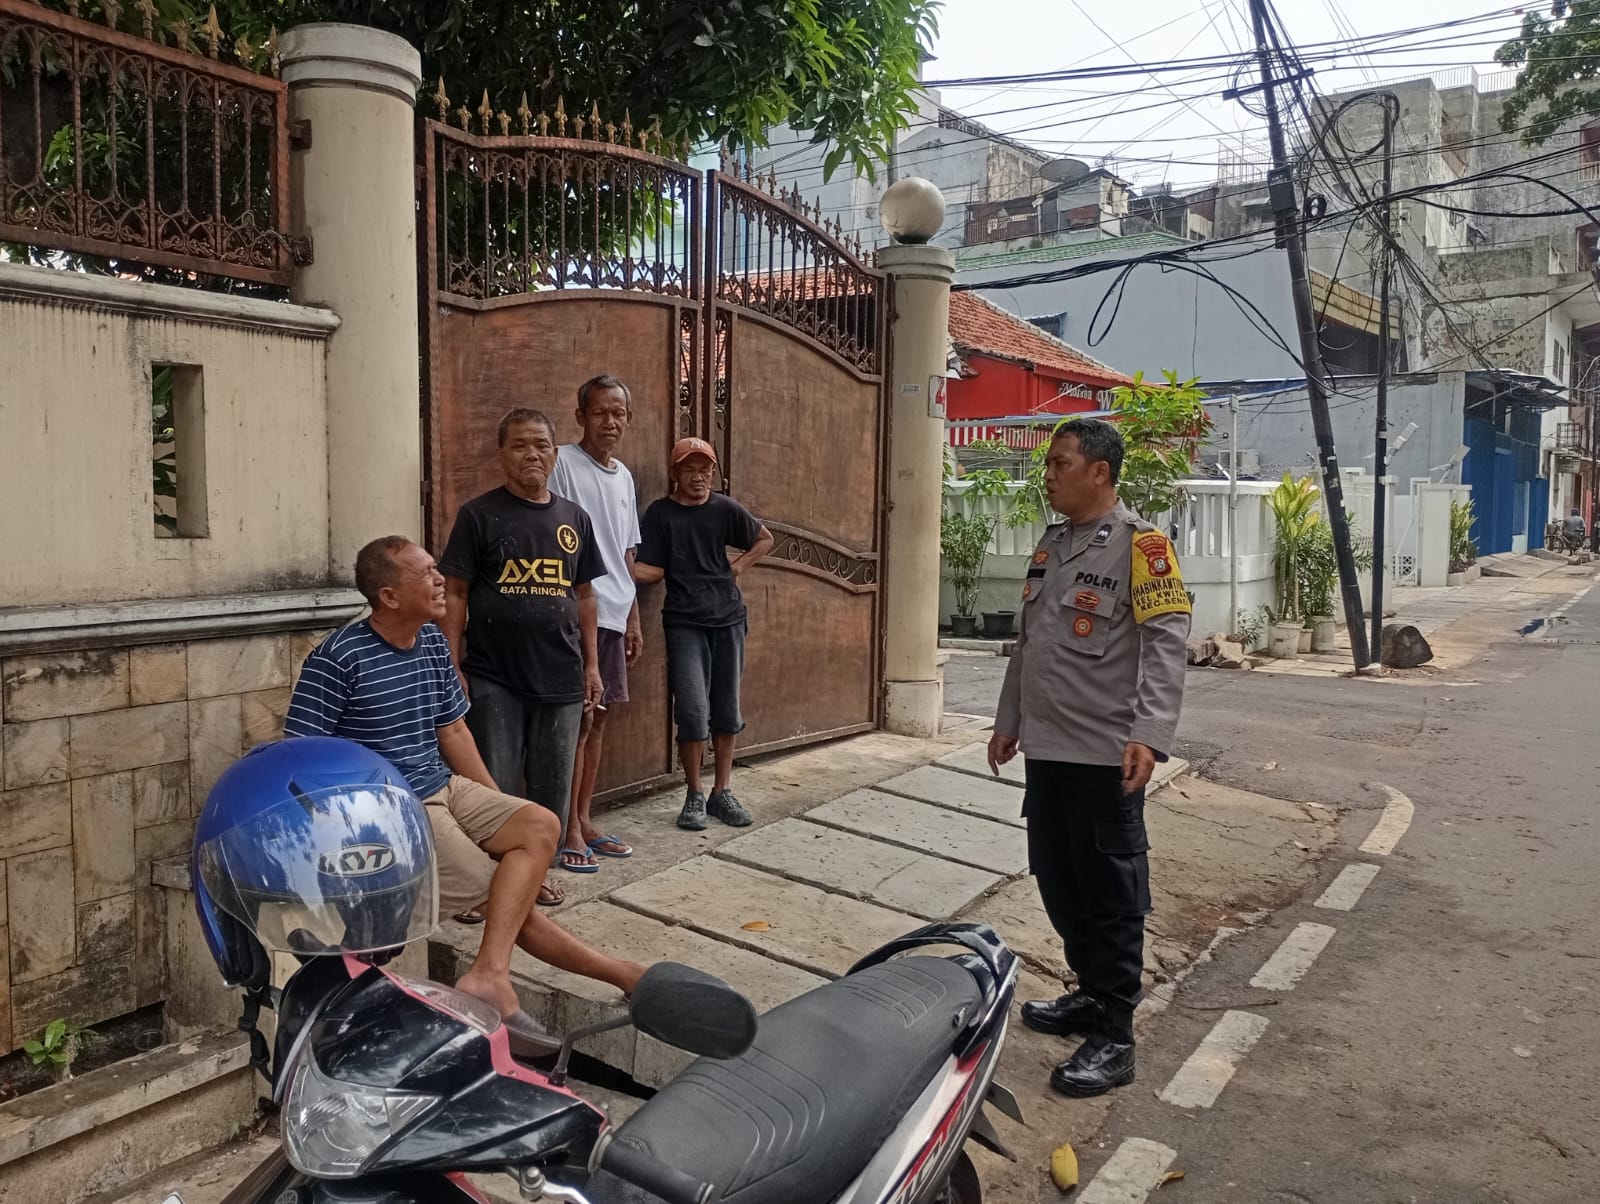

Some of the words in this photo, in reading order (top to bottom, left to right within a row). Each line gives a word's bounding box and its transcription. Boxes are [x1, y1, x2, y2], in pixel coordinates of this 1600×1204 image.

[496, 558, 572, 586] AXEL
[1075, 572, 1118, 591] POLRI
[500, 586, 528, 594] BATA
[531, 587, 567, 597] RINGAN
[340, 848, 391, 872] KYT
